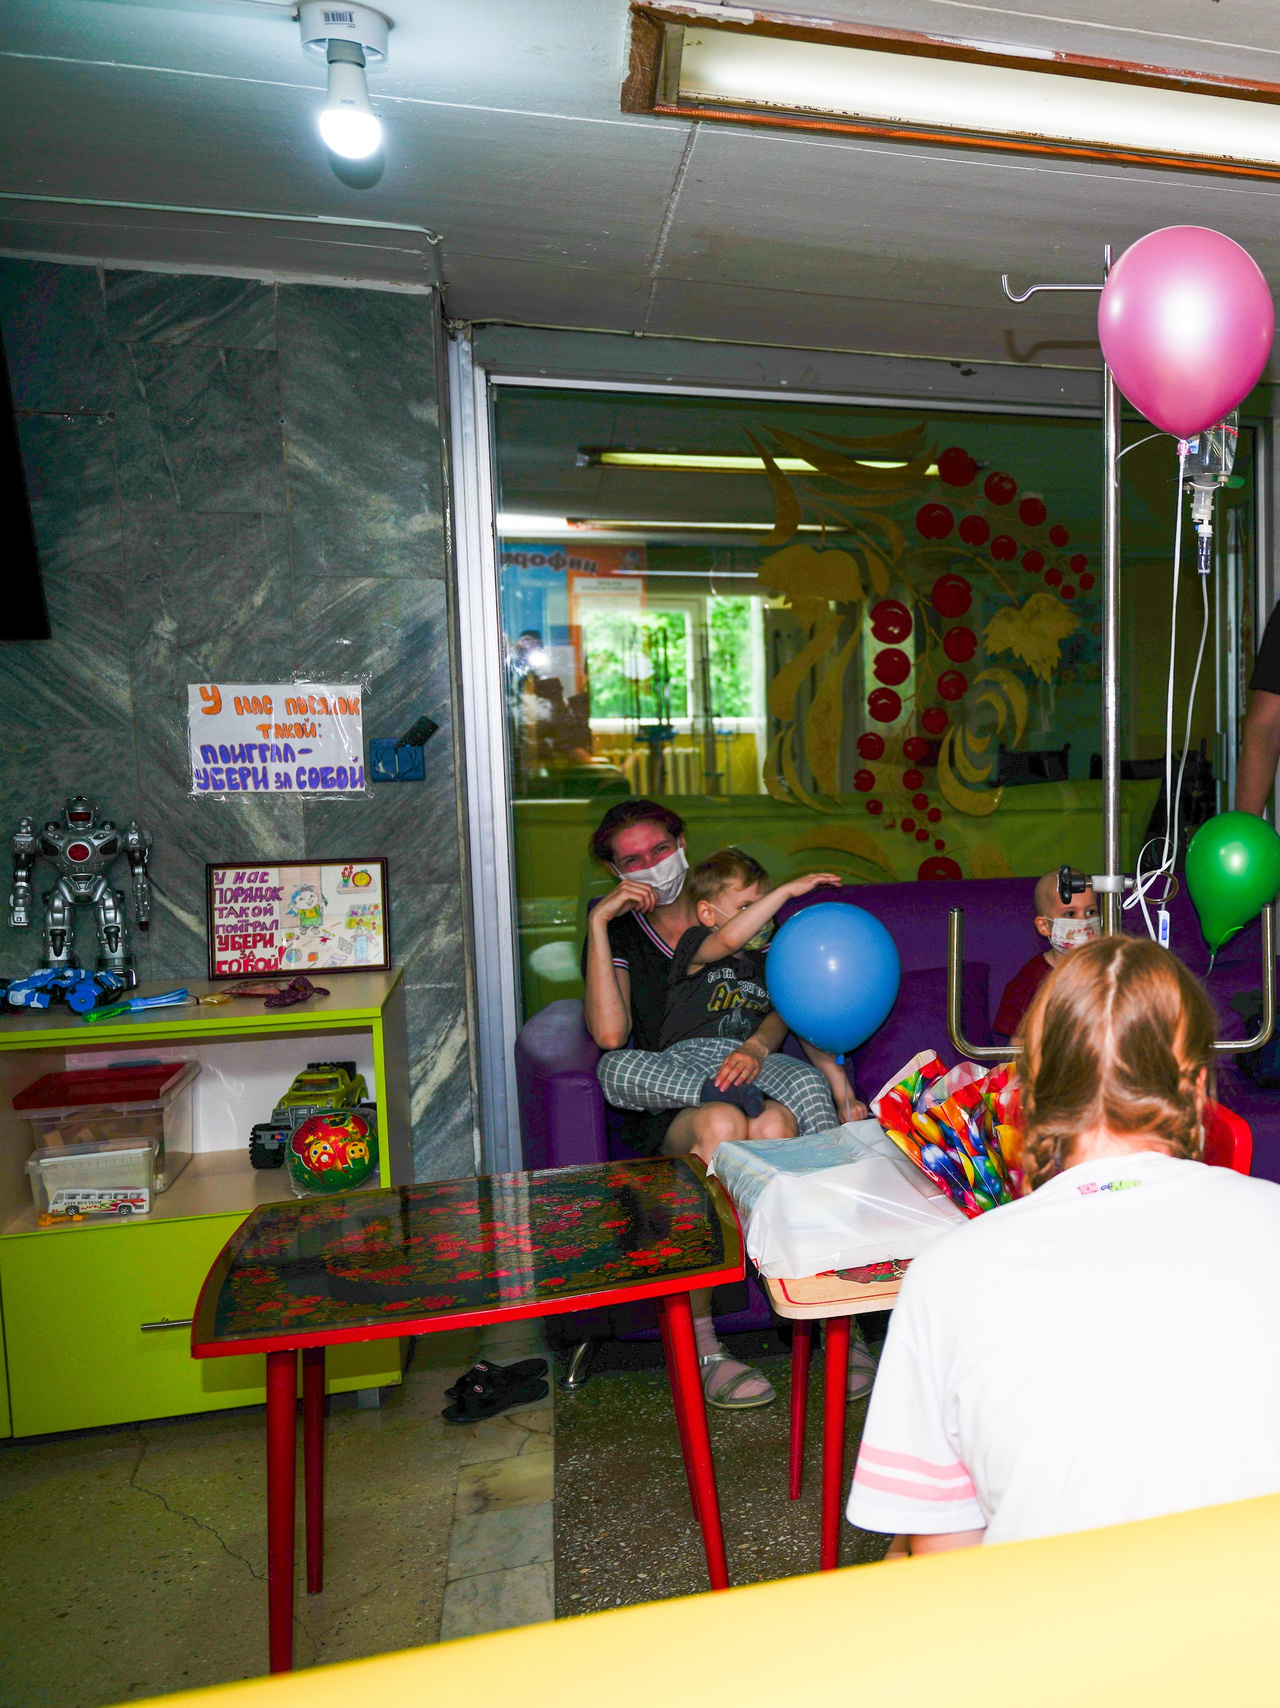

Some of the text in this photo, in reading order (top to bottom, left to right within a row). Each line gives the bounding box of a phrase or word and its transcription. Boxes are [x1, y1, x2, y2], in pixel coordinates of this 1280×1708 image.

[199, 685, 222, 715] У
[234, 695, 273, 716] НАС
[256, 718, 322, 739] ТАКОЙ:
[195, 756, 365, 791] УБЕРИ ЗА СОБОЙ
[214, 871, 226, 885] У
[214, 886, 284, 905] ПОРЯДОК
[214, 903, 274, 919] ТАКОЙ
[239, 949, 256, 960] ЗА
